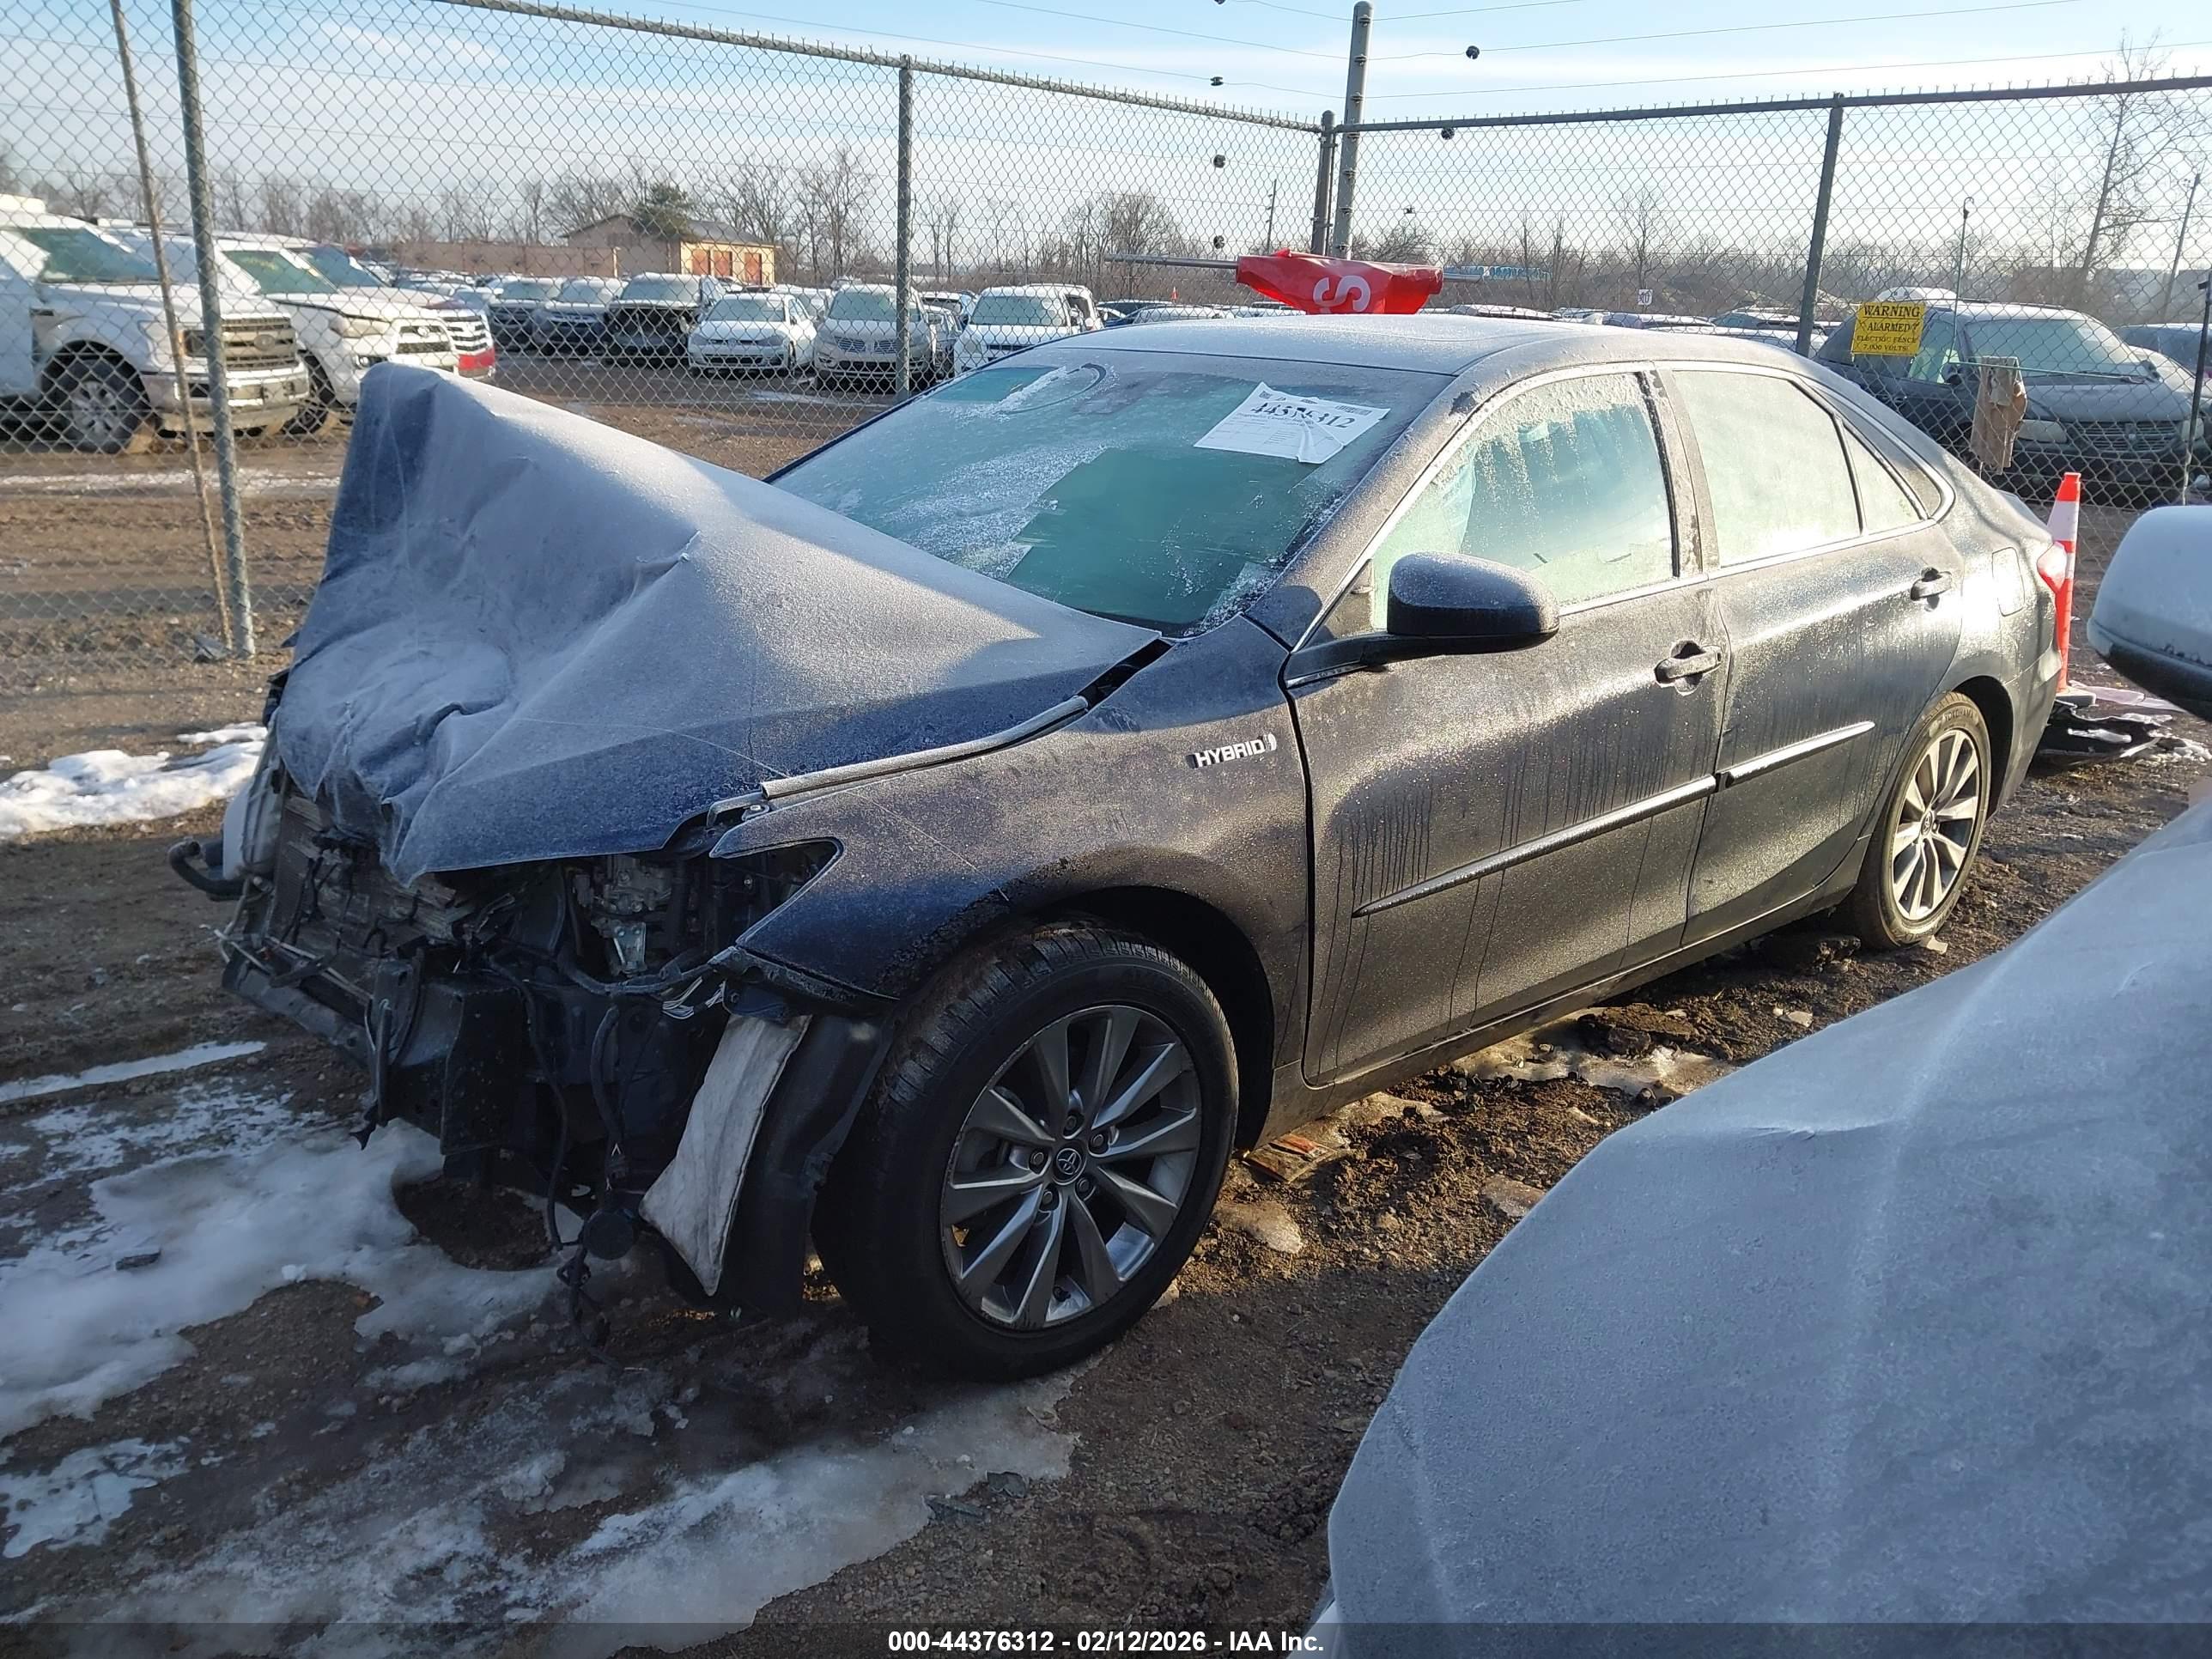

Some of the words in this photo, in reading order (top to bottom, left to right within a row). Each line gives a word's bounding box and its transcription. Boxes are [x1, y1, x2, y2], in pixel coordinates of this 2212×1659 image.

[1864, 305, 1921, 318] WARNING
[1867, 321, 1911, 332] ALARMED
[1194, 739, 1266, 767] HYBRID
